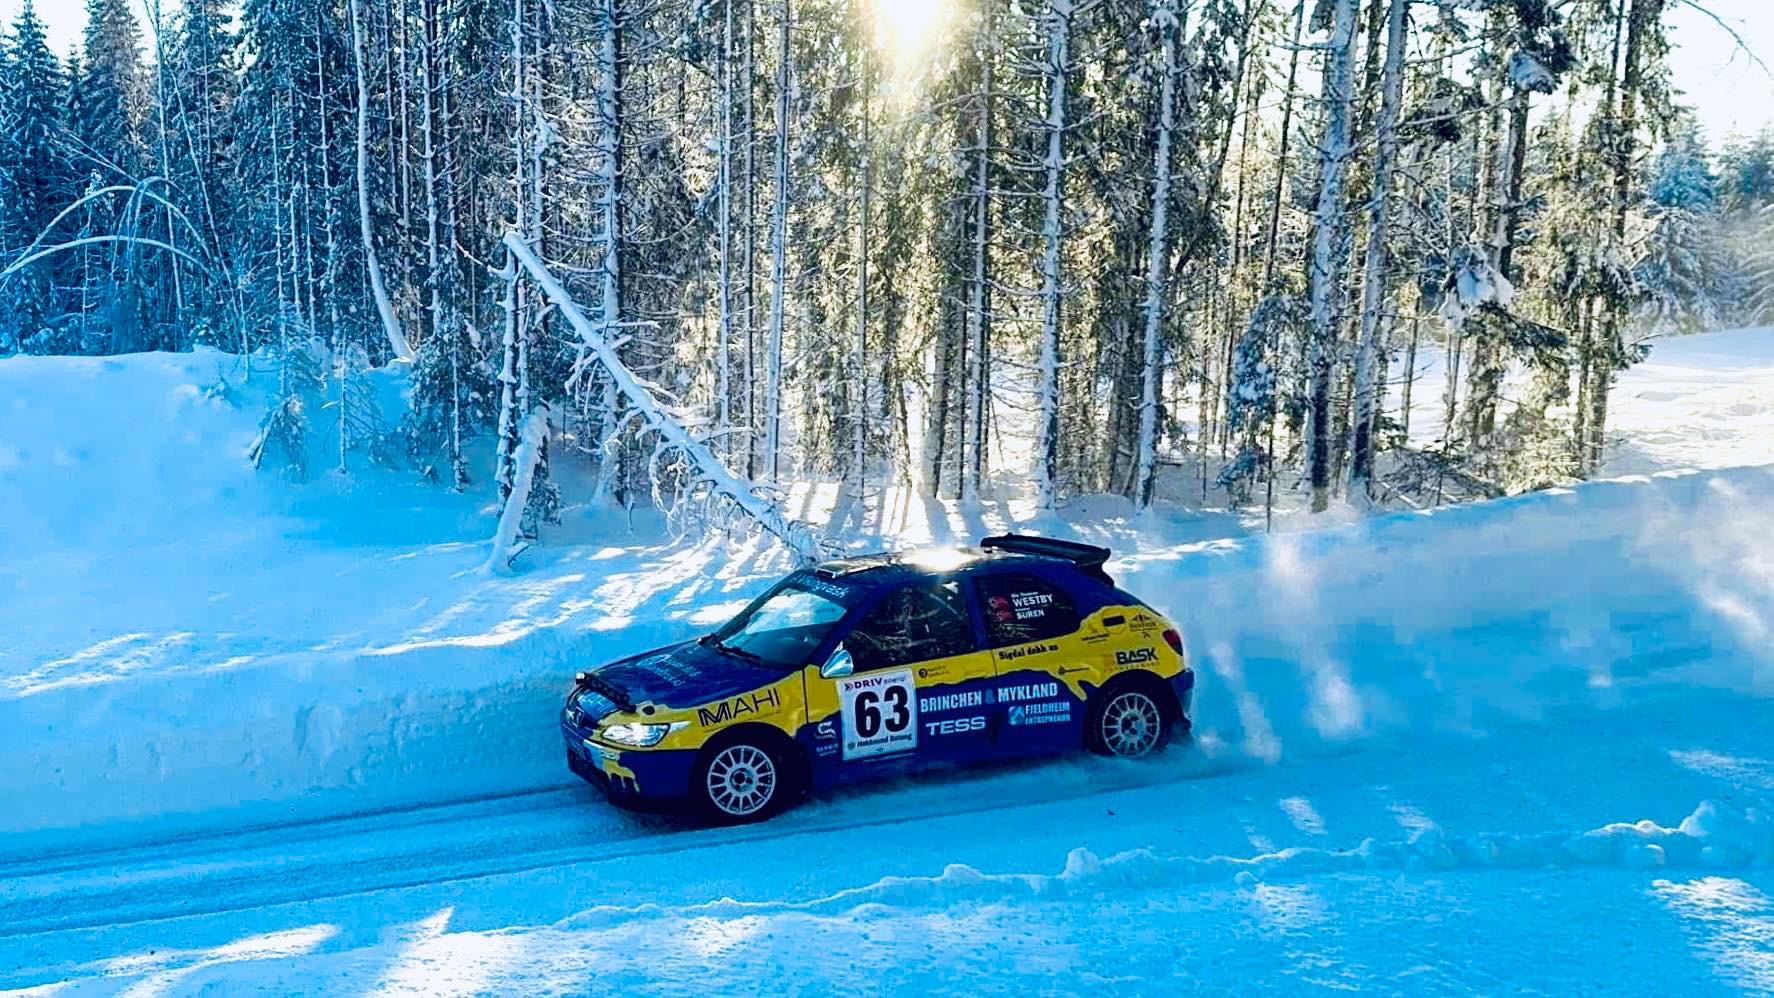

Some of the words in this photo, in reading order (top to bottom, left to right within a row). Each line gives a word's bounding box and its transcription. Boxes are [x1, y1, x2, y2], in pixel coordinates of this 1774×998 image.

[1012, 594, 1053, 607] WESTBY
[1115, 647, 1158, 665] BASK
[854, 677, 883, 689] DRIV
[697, 687, 780, 727] MAHI
[920, 691, 982, 713] BRINCHEN
[998, 682, 1058, 703] MYKLAND
[854, 685, 910, 738] 63
[925, 716, 986, 736] TESS
